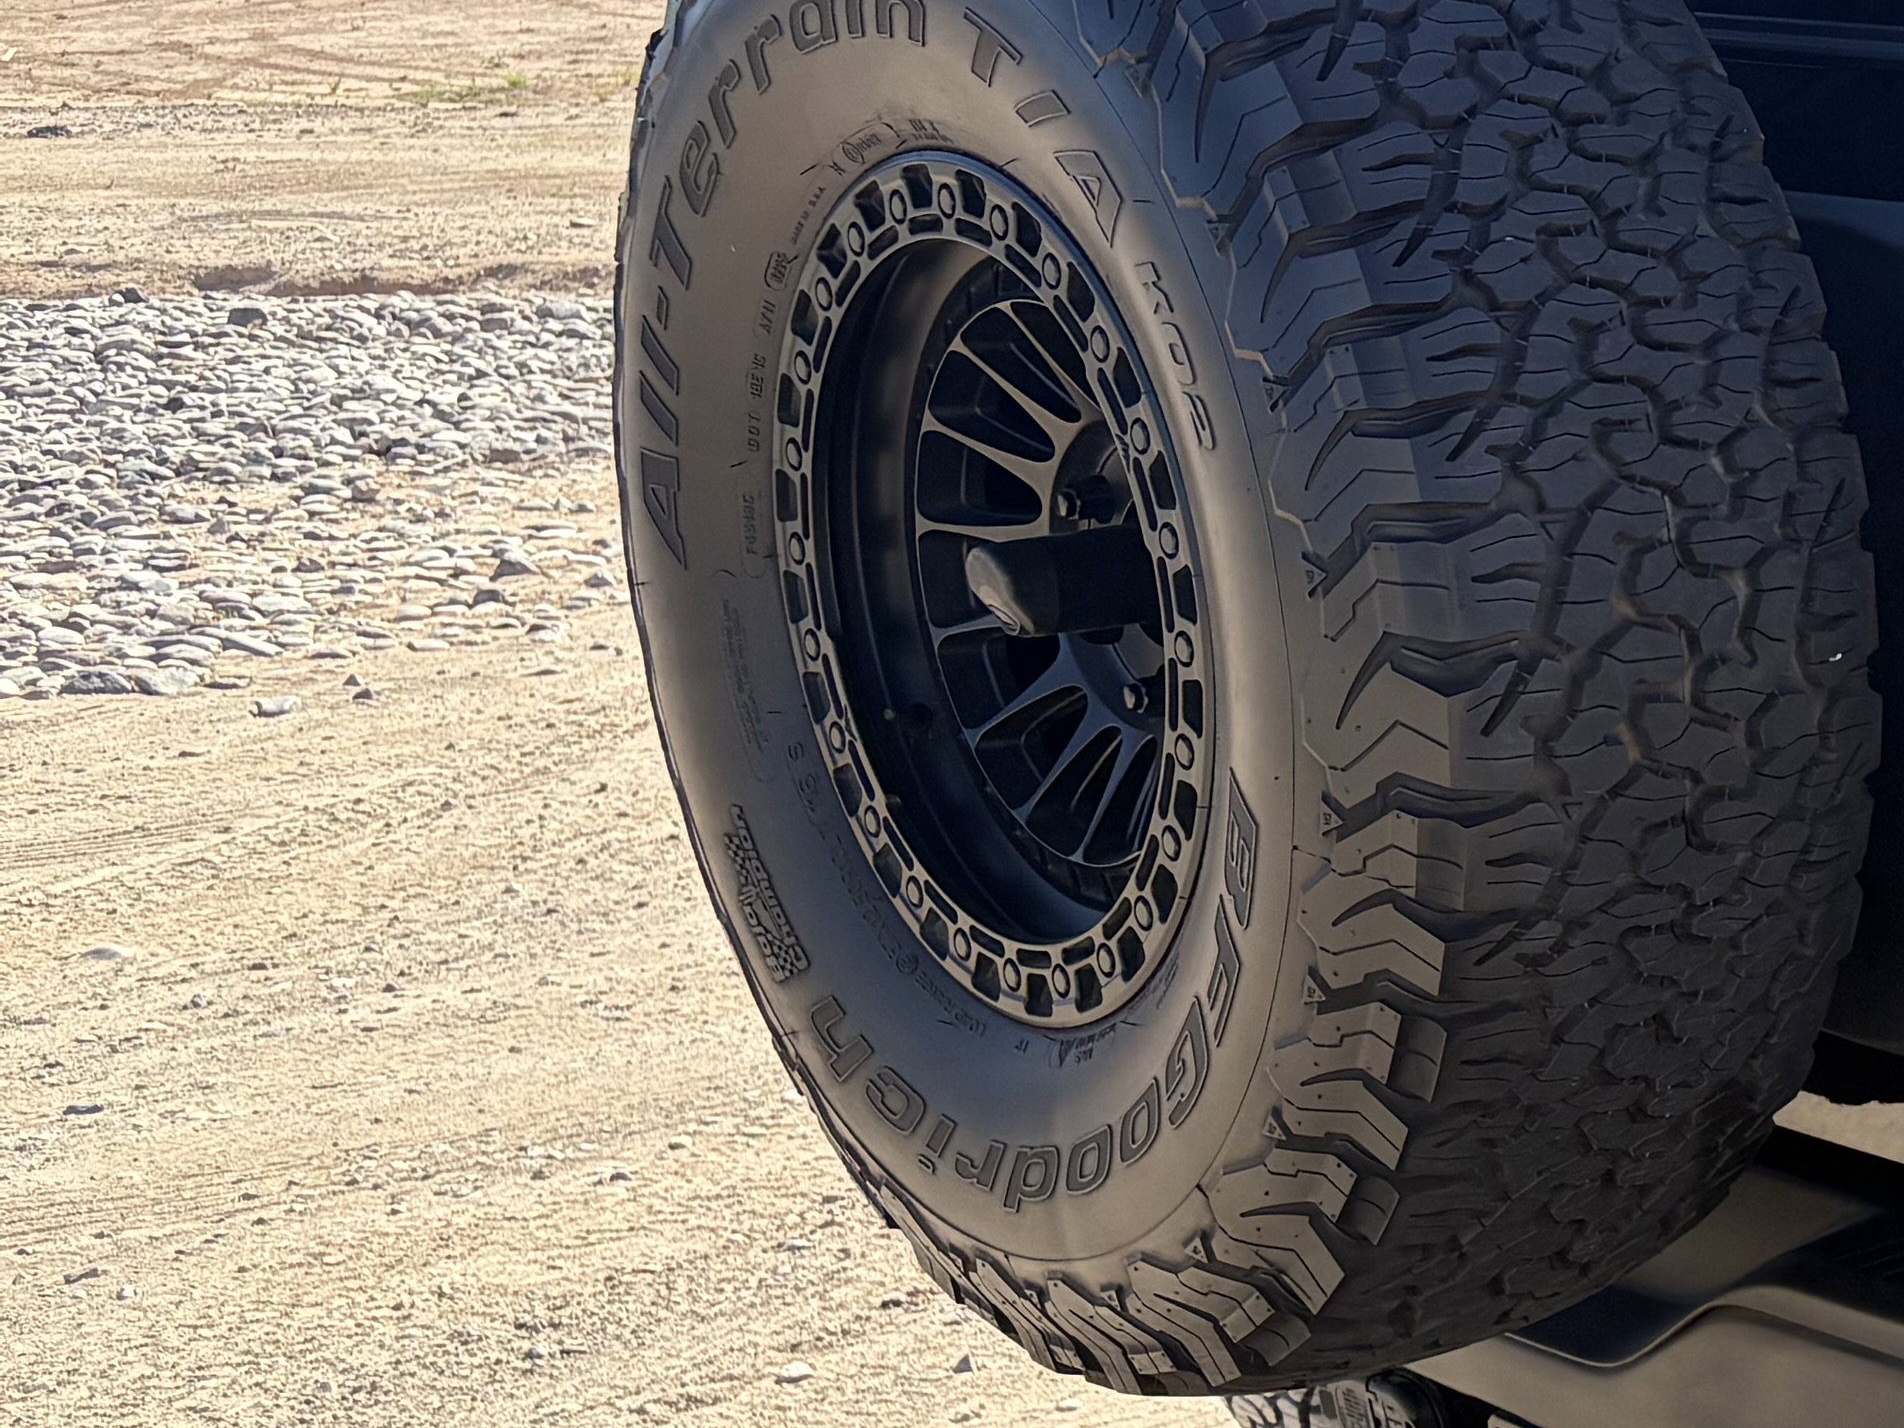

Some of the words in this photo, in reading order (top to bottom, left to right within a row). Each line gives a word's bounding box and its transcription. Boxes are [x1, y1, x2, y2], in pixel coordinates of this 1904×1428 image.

[1134, 260, 1217, 452] KO2
[727, 803, 810, 971] Champion
[740, 903, 786, 984] Baja
